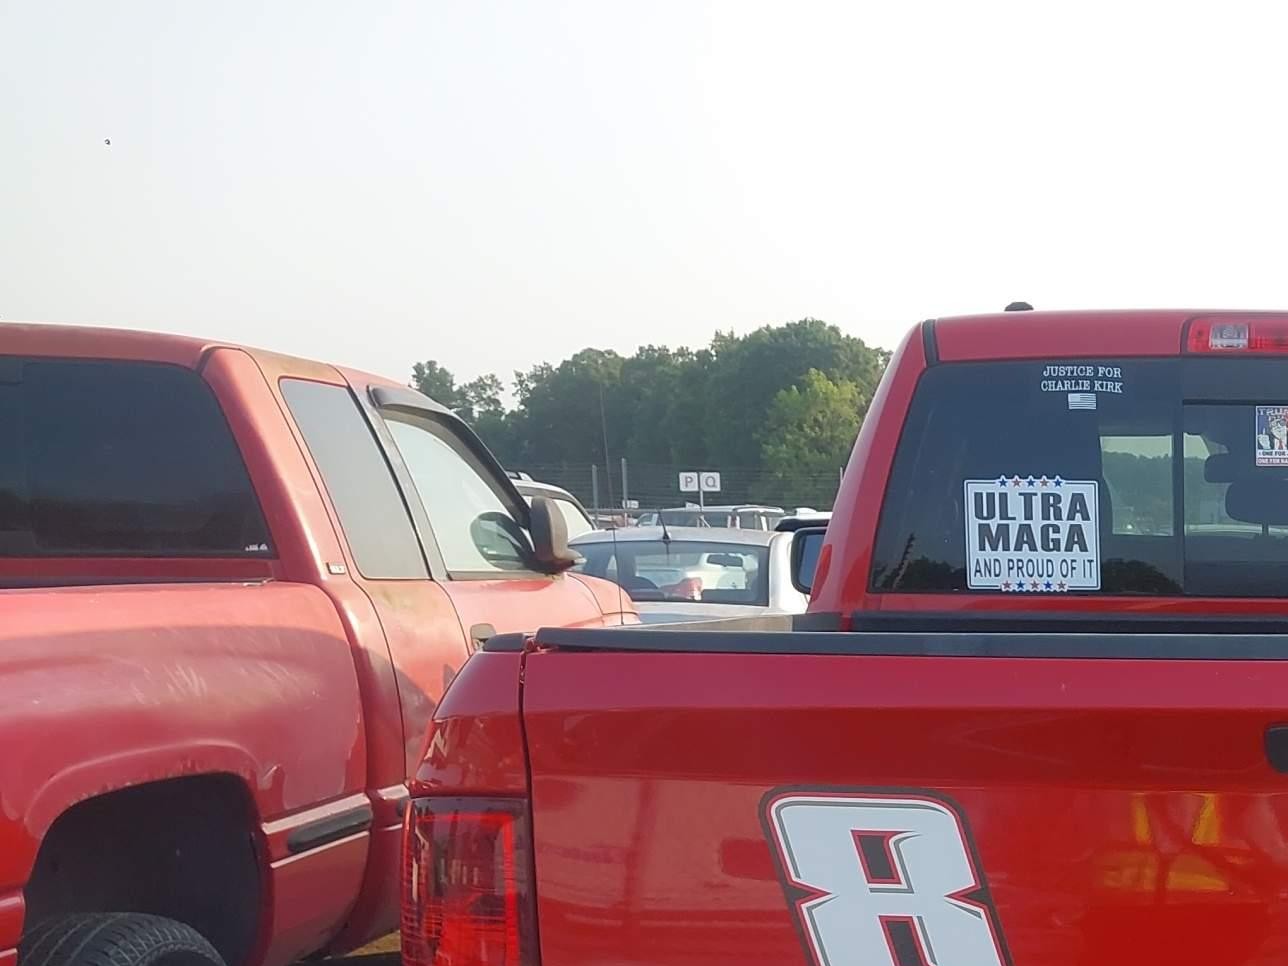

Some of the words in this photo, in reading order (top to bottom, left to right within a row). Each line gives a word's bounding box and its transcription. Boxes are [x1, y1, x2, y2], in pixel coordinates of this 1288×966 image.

[1043, 366, 1094, 376] JUSTICE
[1098, 366, 1122, 378] FOR
[1041, 380, 1090, 391] CHARLIE
[1094, 381, 1123, 393] KIRK
[684, 476, 694, 488] P
[705, 476, 717, 488] Q
[974, 492, 1091, 521] ULTRA
[978, 523, 1089, 552] MAGA
[974, 558, 1002, 578] AND
[1007, 558, 1055, 578] PROUD
[1060, 559, 1077, 578] OF
[1083, 559, 1094, 578] IT
